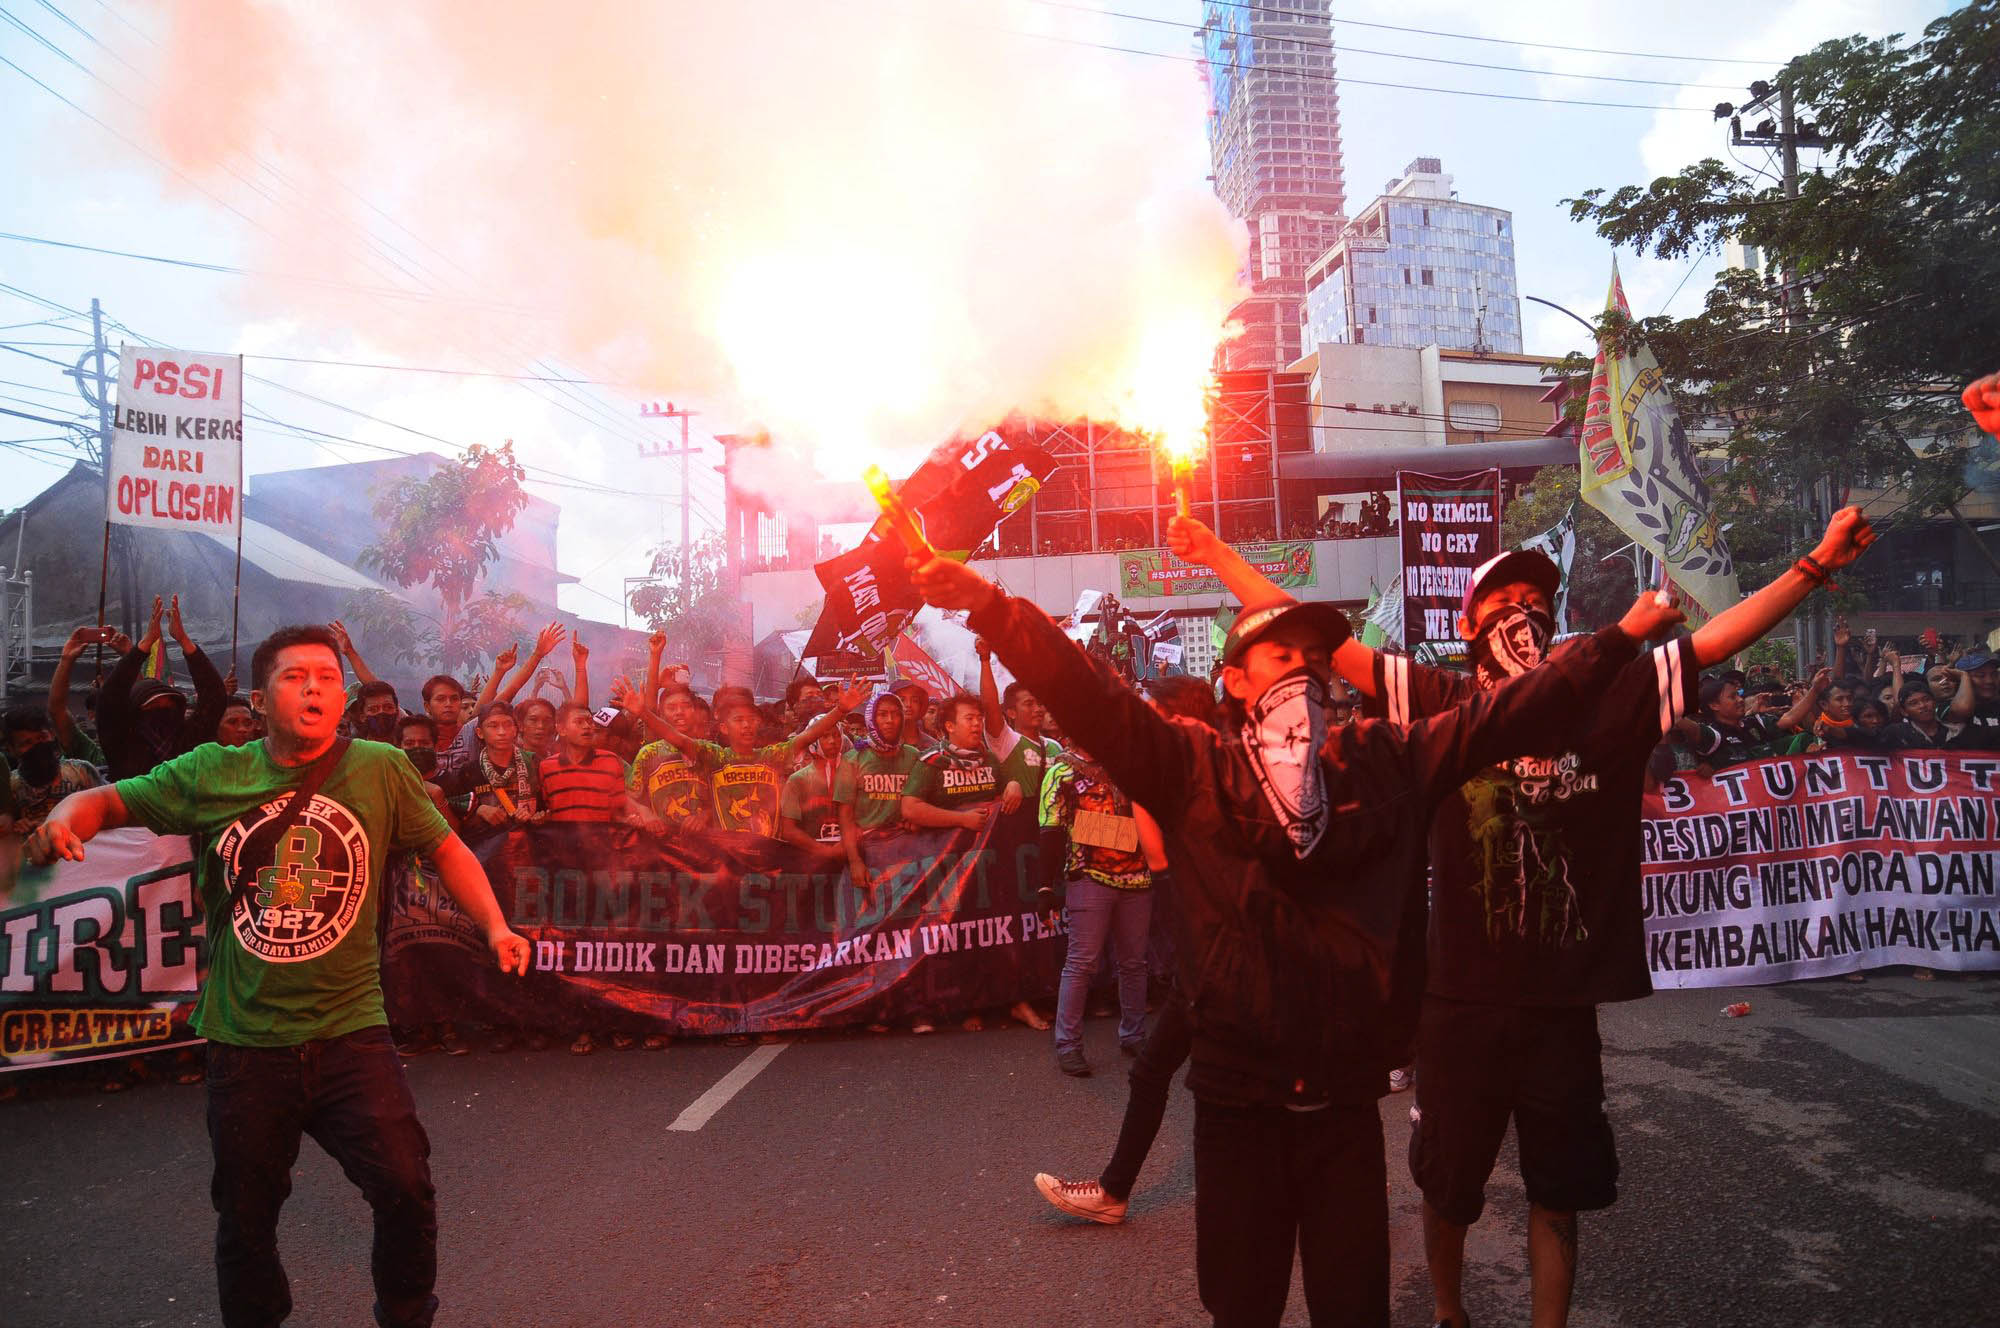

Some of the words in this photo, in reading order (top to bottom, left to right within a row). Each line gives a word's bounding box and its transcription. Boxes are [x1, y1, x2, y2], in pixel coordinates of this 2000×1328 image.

[133, 358, 223, 400] PSSI
[114, 404, 167, 436] LEBIH
[175, 415, 243, 441] KERAS
[143, 446, 204, 474] DARI
[117, 475, 234, 524] OPLOSAN
[1407, 501, 1428, 522] NO
[1432, 502, 1493, 523] KIMCIL
[1421, 532, 1442, 553] NO
[1446, 533, 1479, 553] CRY
[1151, 570, 1187, 579] #SAVE
[1191, 567, 1217, 577] PER
[1260, 563, 1286, 572] 1927
[1406, 565, 1419, 597] NO
[1424, 608, 1450, 640] WE
[863, 774, 909, 793] BONE
[942, 766, 996, 788] BONEK
[260, 799, 338, 819] BOEK
[1662, 776, 1696, 813] 3
[1804, 795, 1988, 848] MELAWAN
[1758, 850, 1913, 908] MENPORA
[1916, 850, 1996, 898] DAN
[512, 865, 718, 932] BONEK
[255, 908, 325, 930] 1927
[242, 927, 291, 957] SURABAYA
[294, 930, 334, 956] FAMILY
[535, 941, 565, 971] DI
[574, 941, 656, 972] DIDIK
[665, 943, 726, 974] DAN
[734, 928, 912, 974] DIBESARKAN
[920, 914, 1013, 956] UNTUK
[1650, 913, 1863, 973] KEMBALIKAN
[3, 1011, 168, 1053] CREATIVE
